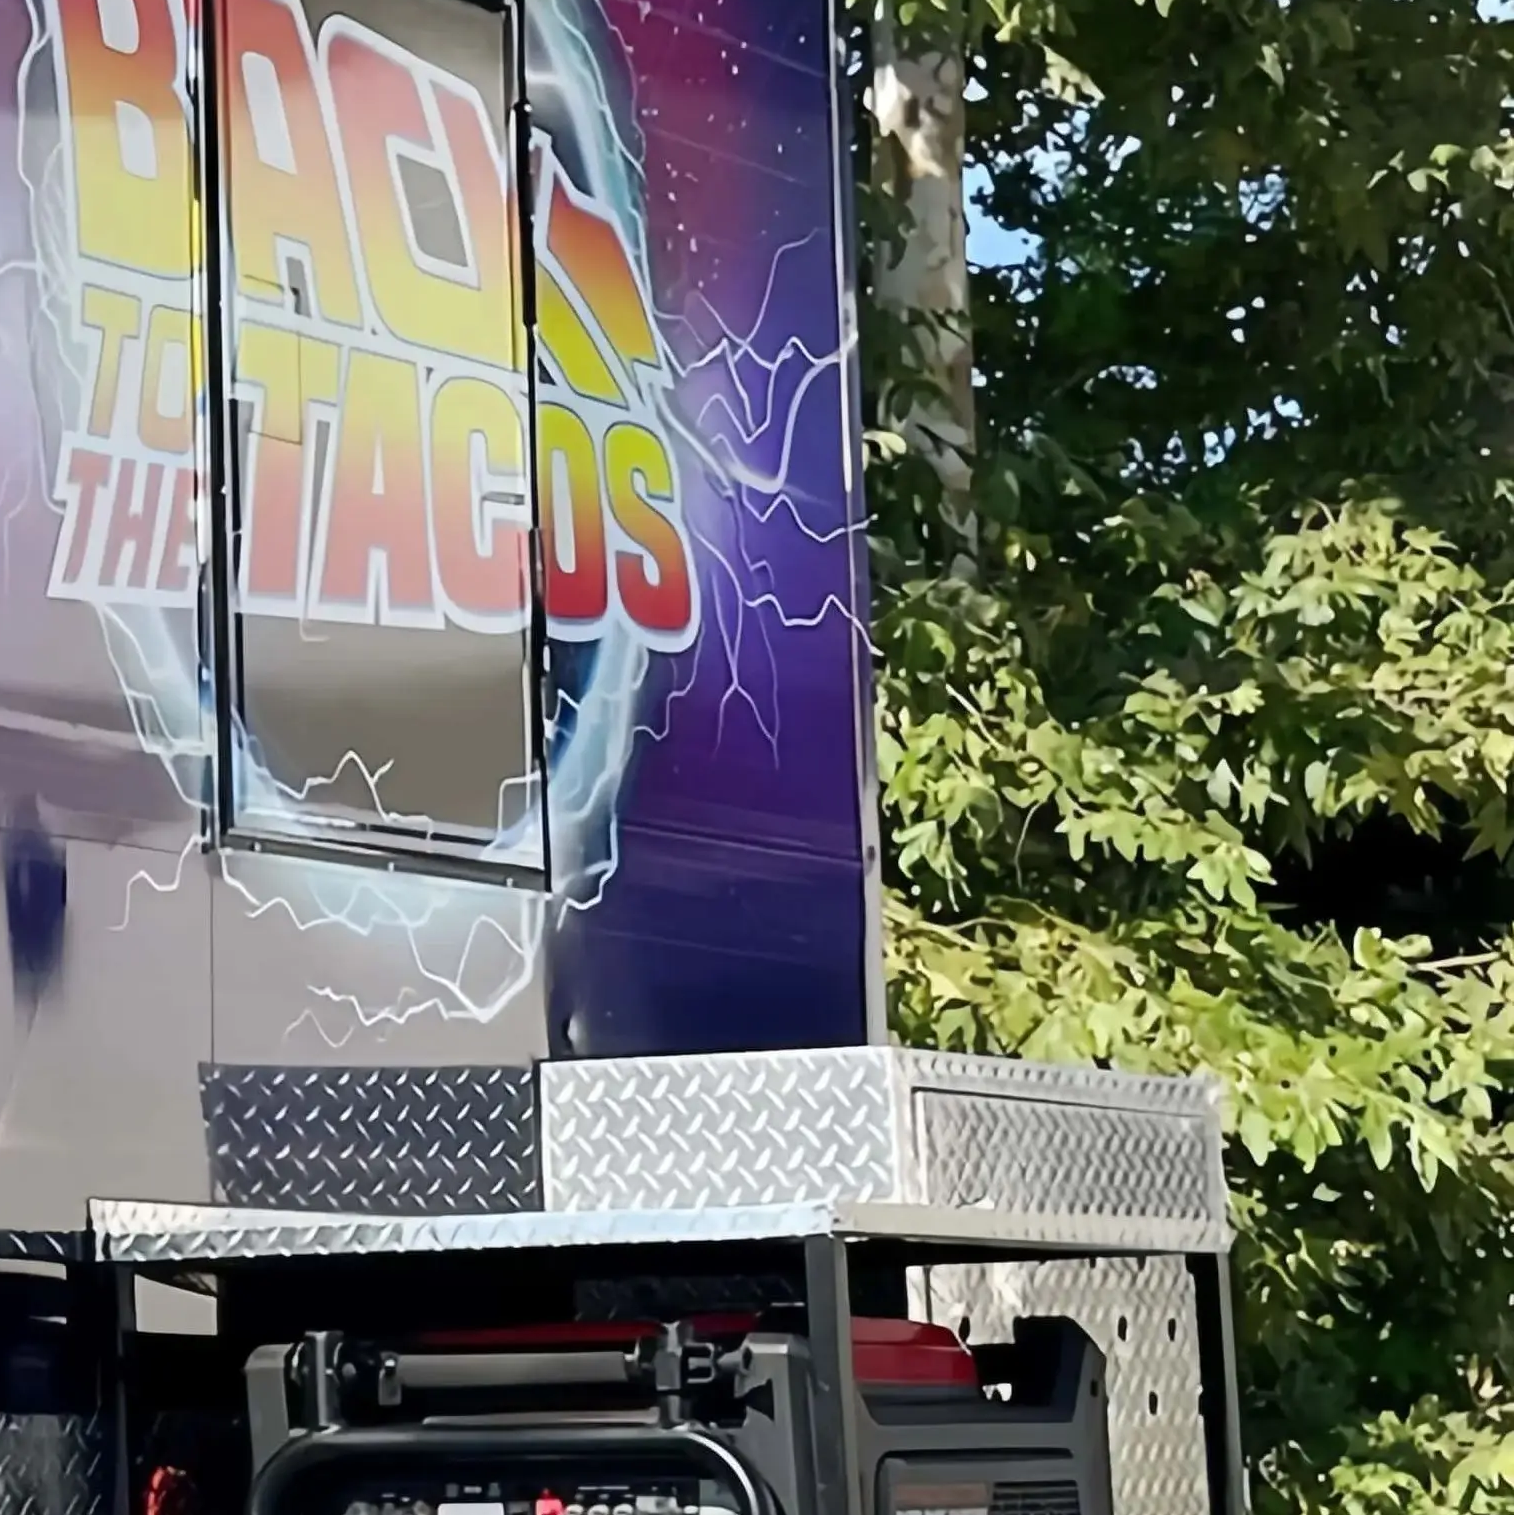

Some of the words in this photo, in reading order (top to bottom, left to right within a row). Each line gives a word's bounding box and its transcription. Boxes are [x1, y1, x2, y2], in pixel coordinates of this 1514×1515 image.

[80, 282, 205, 454] TO
[61, 447, 205, 592] THE
[235, 323, 693, 630] TACOS
